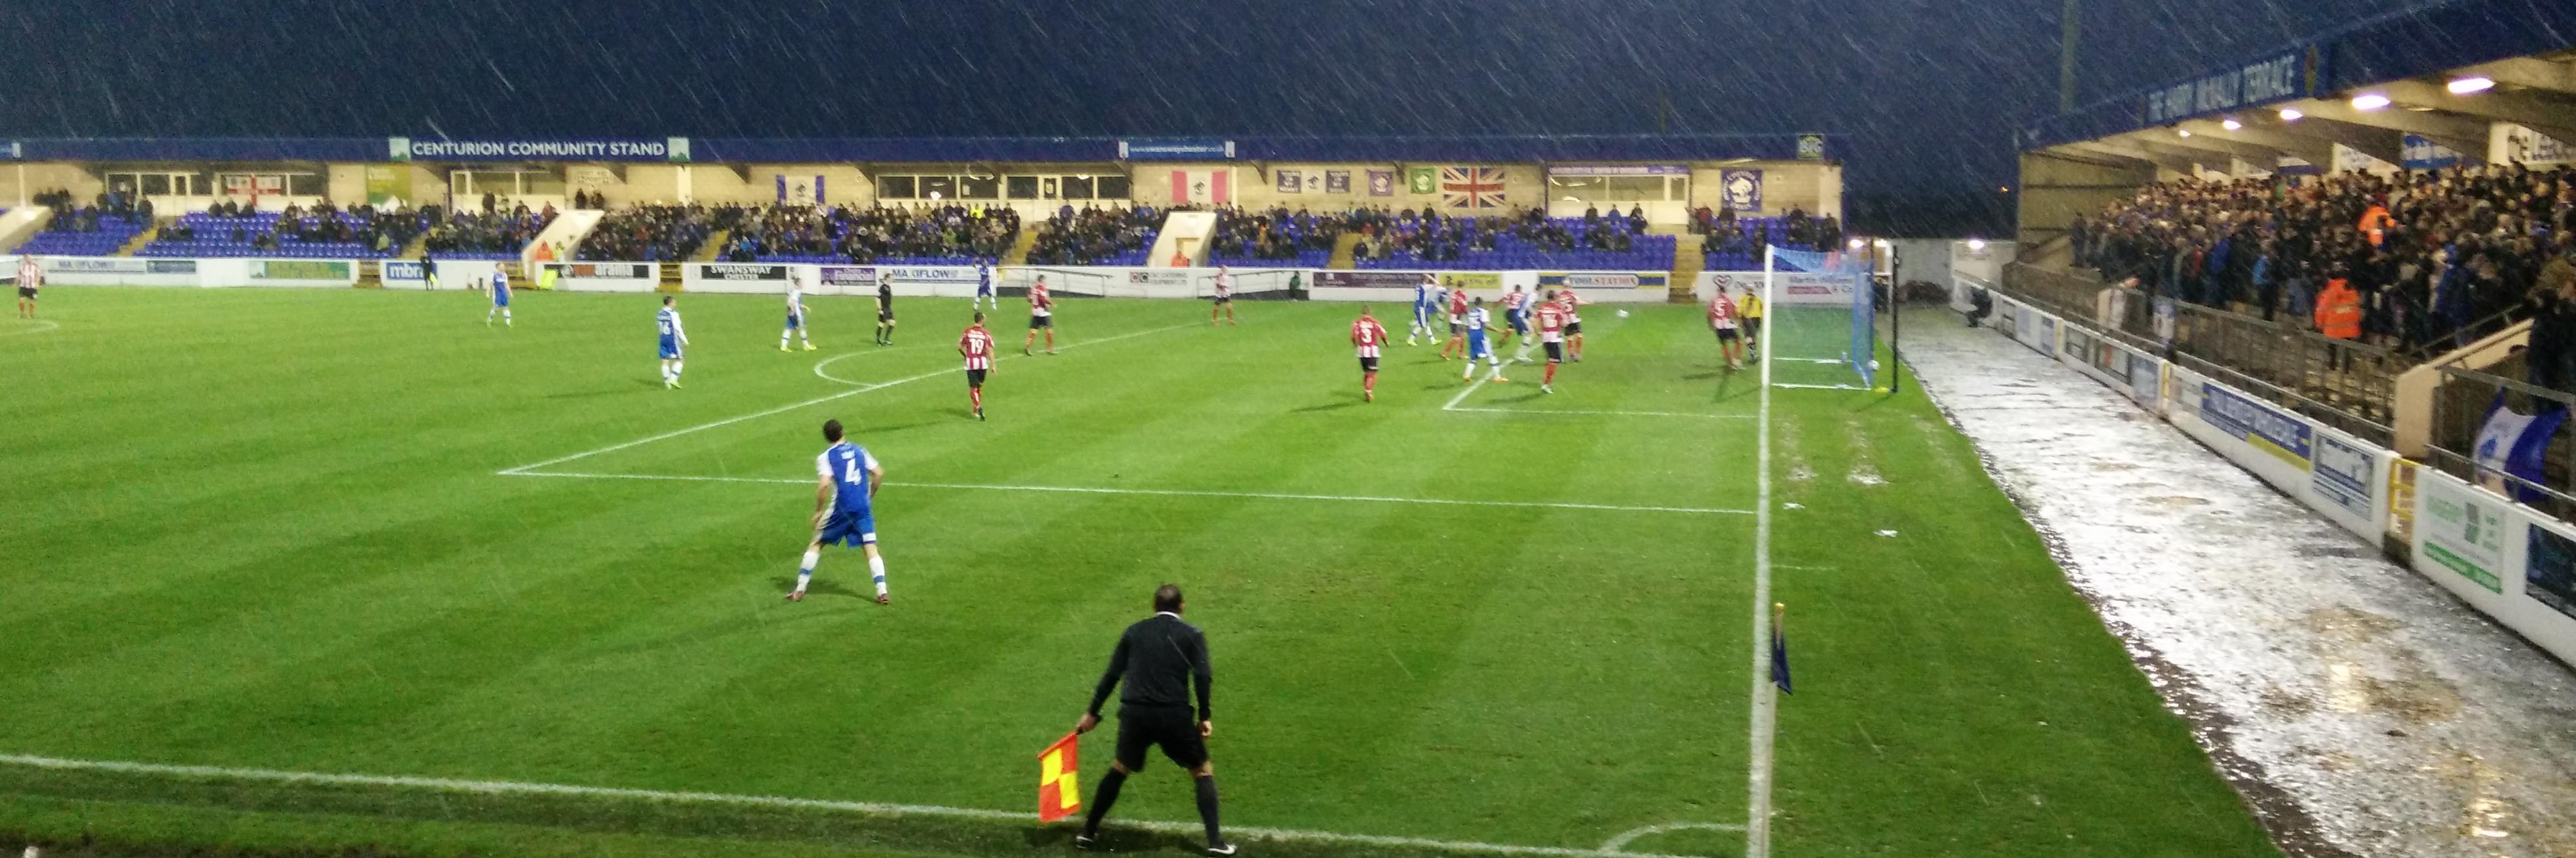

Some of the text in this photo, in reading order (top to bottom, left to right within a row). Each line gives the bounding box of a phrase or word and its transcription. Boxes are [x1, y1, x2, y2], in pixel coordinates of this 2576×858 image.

[412, 141, 665, 156] CENTURION COMMUNITY STAND
[389, 263, 425, 278] mbn
[710, 265, 772, 274] SWANSWAY
[1715, 303, 1726, 317] 5
[1361, 327, 1372, 343] 3
[969, 338, 985, 354] 19
[845, 458, 861, 485] 4
